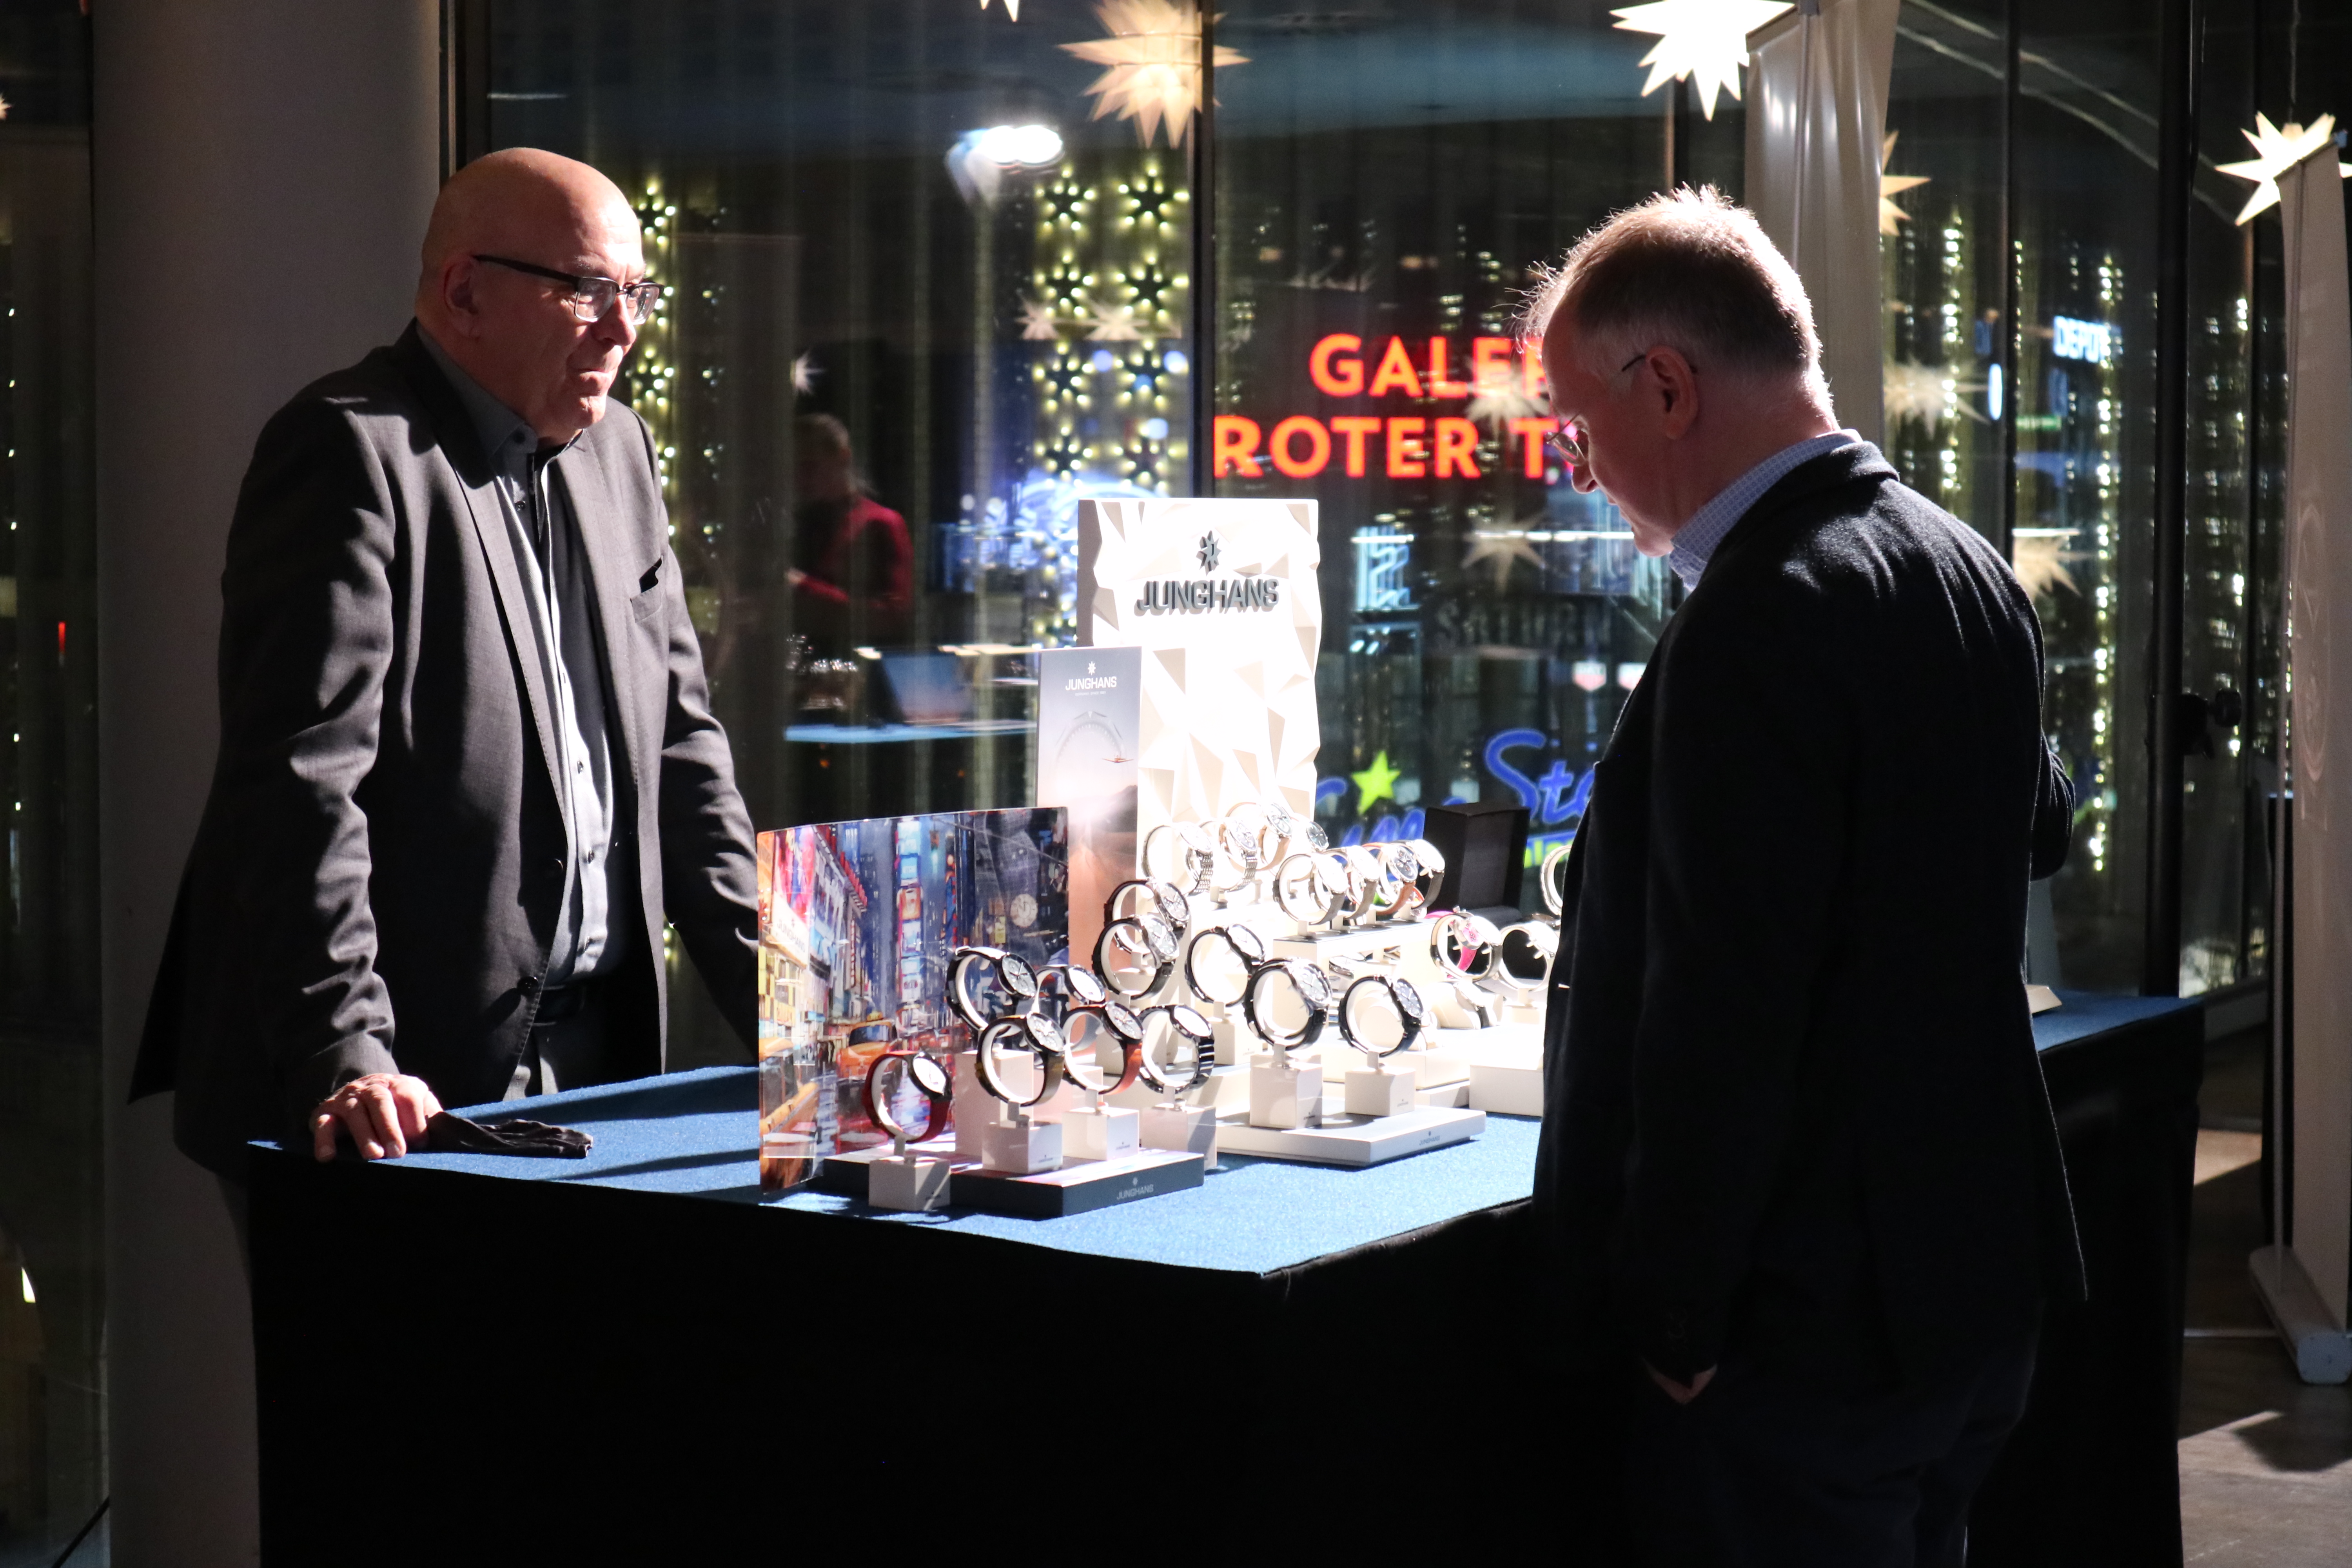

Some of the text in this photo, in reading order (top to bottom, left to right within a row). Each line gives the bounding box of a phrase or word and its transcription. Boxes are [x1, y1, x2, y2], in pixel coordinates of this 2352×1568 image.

[1214, 416, 1481, 479] ROTER
[1137, 578, 1279, 610] JUNGHANS
[1065, 676, 1117, 691] JUNGHANS
[1116, 1184, 1154, 1200] JUNGHANS
